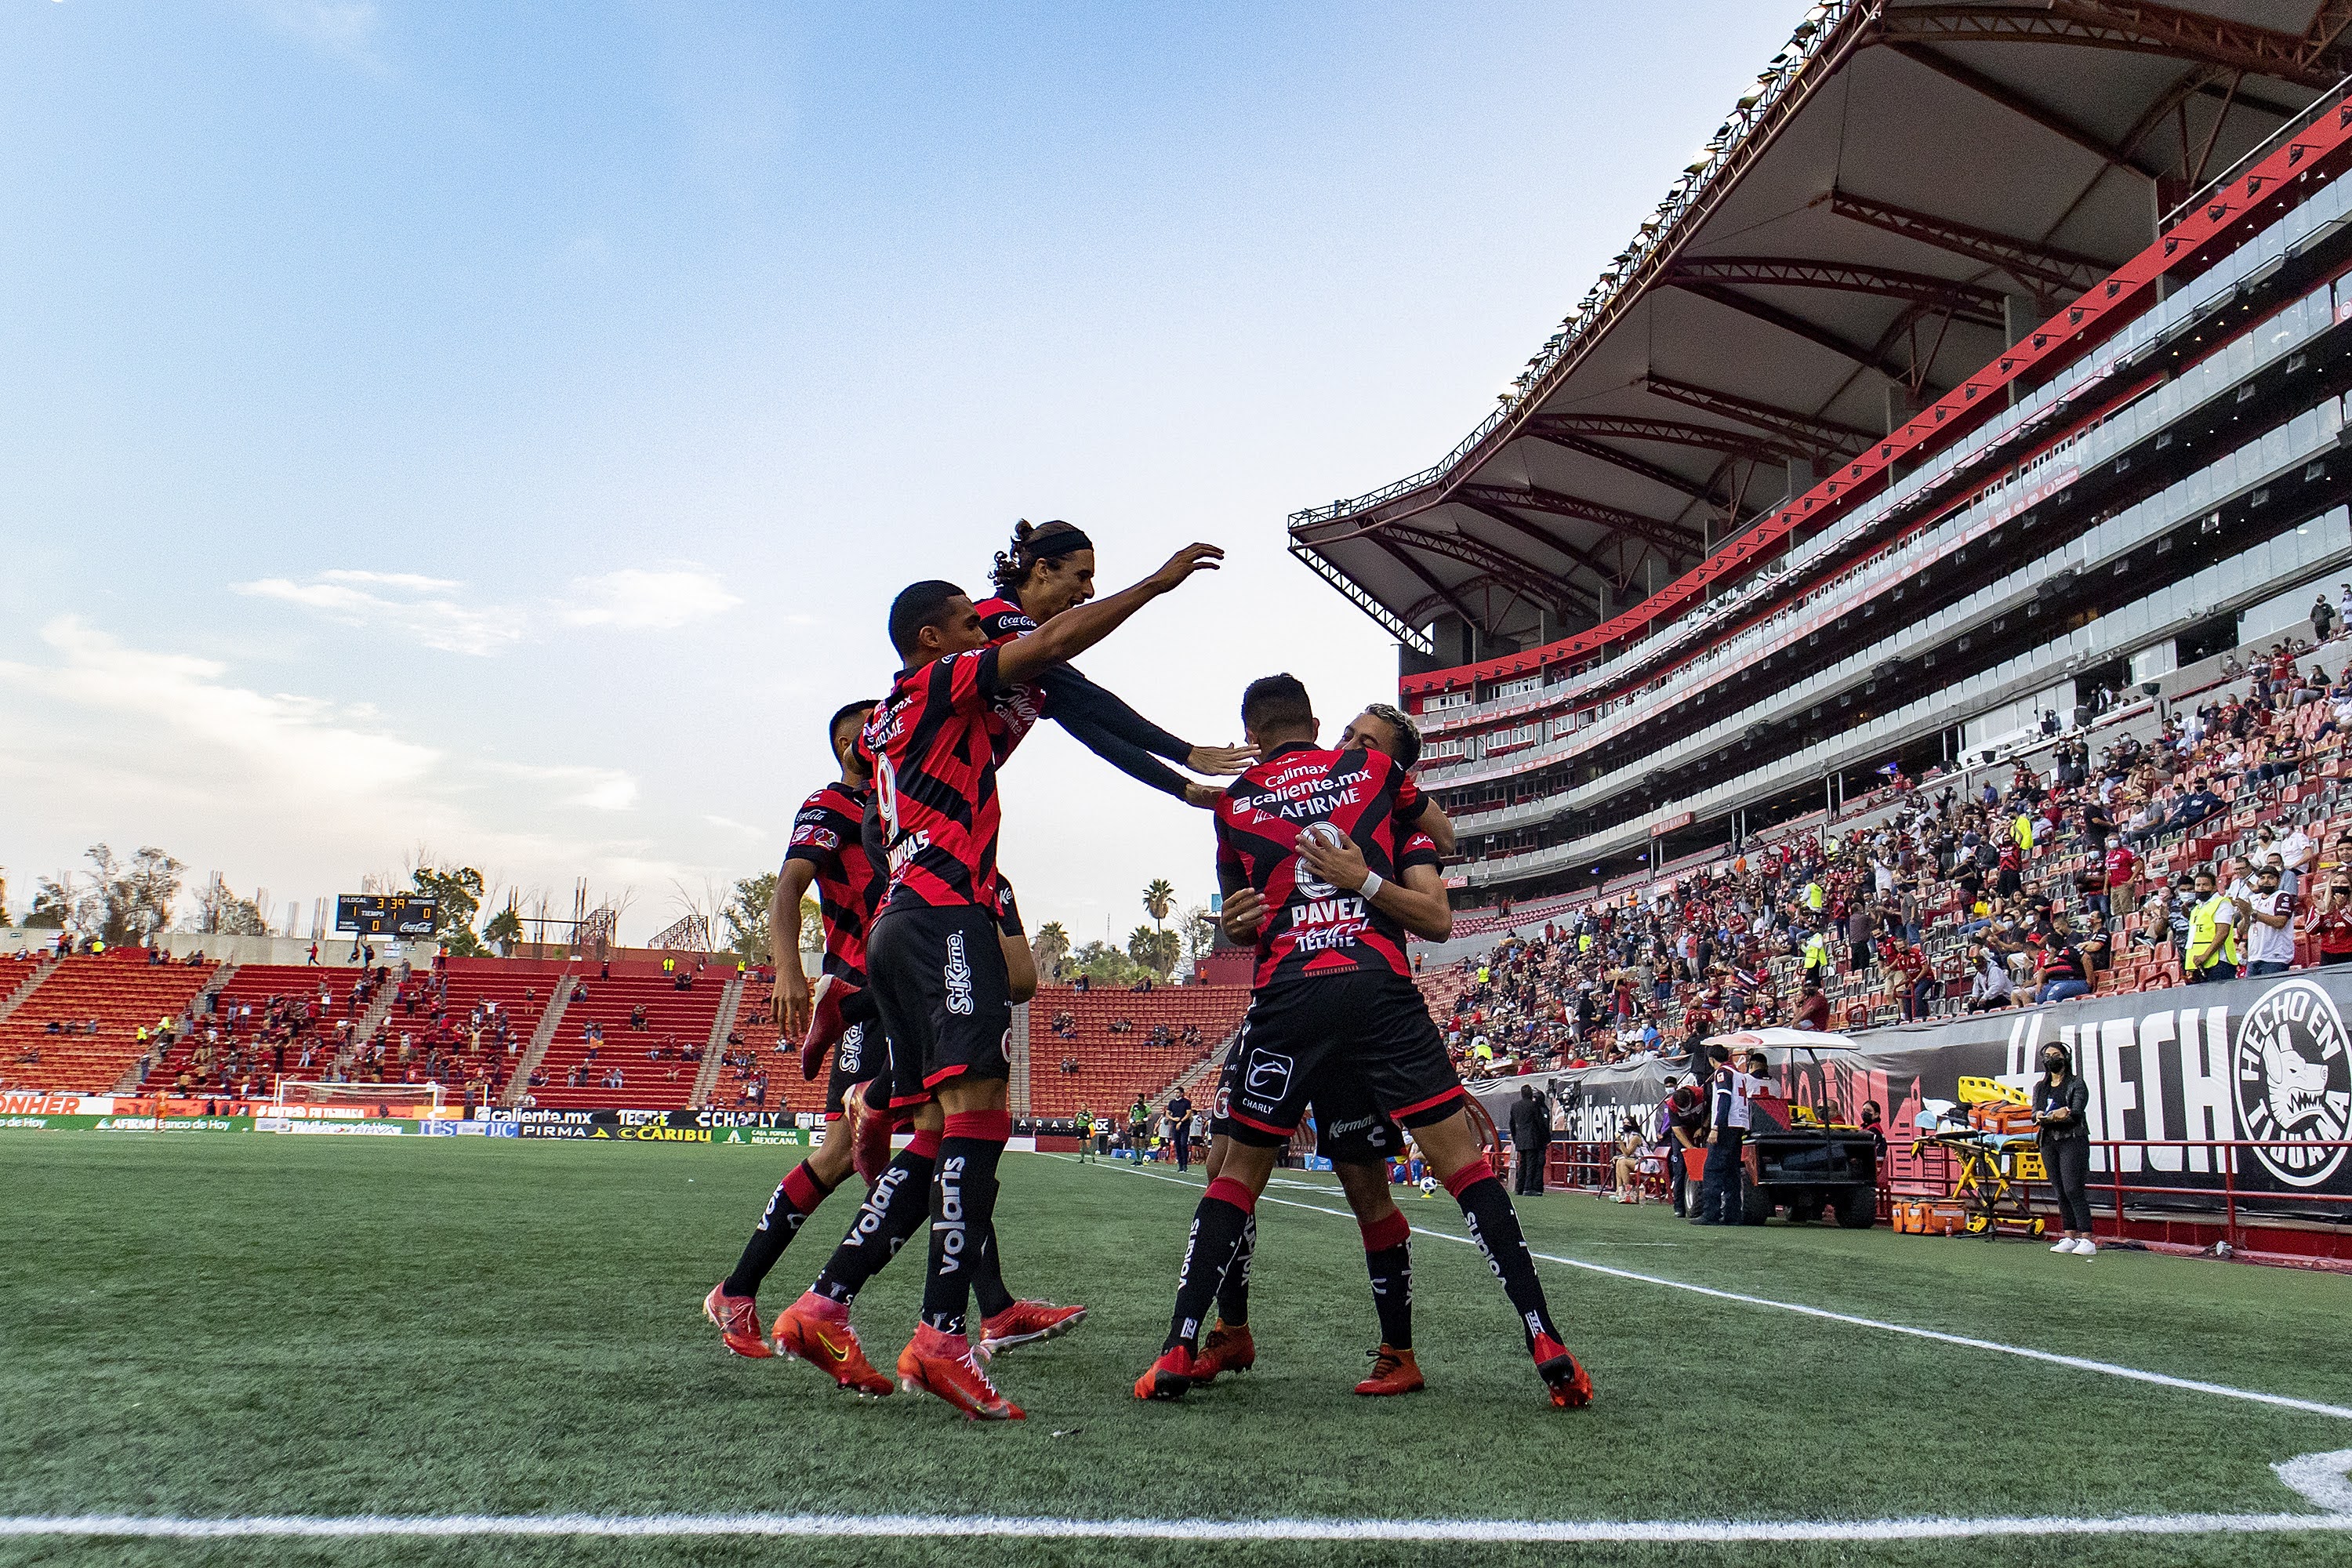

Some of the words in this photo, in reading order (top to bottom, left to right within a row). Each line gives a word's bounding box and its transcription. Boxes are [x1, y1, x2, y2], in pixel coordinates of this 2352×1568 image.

[1265, 764, 1330, 788] Calimax
[1252, 769, 1373, 806] caliente.mx
[1279, 787, 1361, 818] AFIRME
[1291, 896, 1366, 927] PAVEZ
[1295, 935, 1356, 953] TECATE
[2241, 990, 2311, 1081] HECHO
[2305, 1002, 2342, 1062] EN
[1242, 1098, 1274, 1115] CHARLY
[23, 1117, 48, 1129] Hoy
[193, 1118, 207, 1129] de
[209, 1119, 230, 1131] Hoy
[491, 1107, 593, 1125] caliente.mx
[711, 1111, 780, 1128] CHLY
[522, 1125, 586, 1138] PIRMA
[636, 1128, 712, 1142] CARIBU
[2247, 1090, 2350, 1169] TIJUANA
[750, 1137, 799, 1145] MEXICANA
[842, 1167, 909, 1247] volaris
[933, 1156, 966, 1276] volaris
